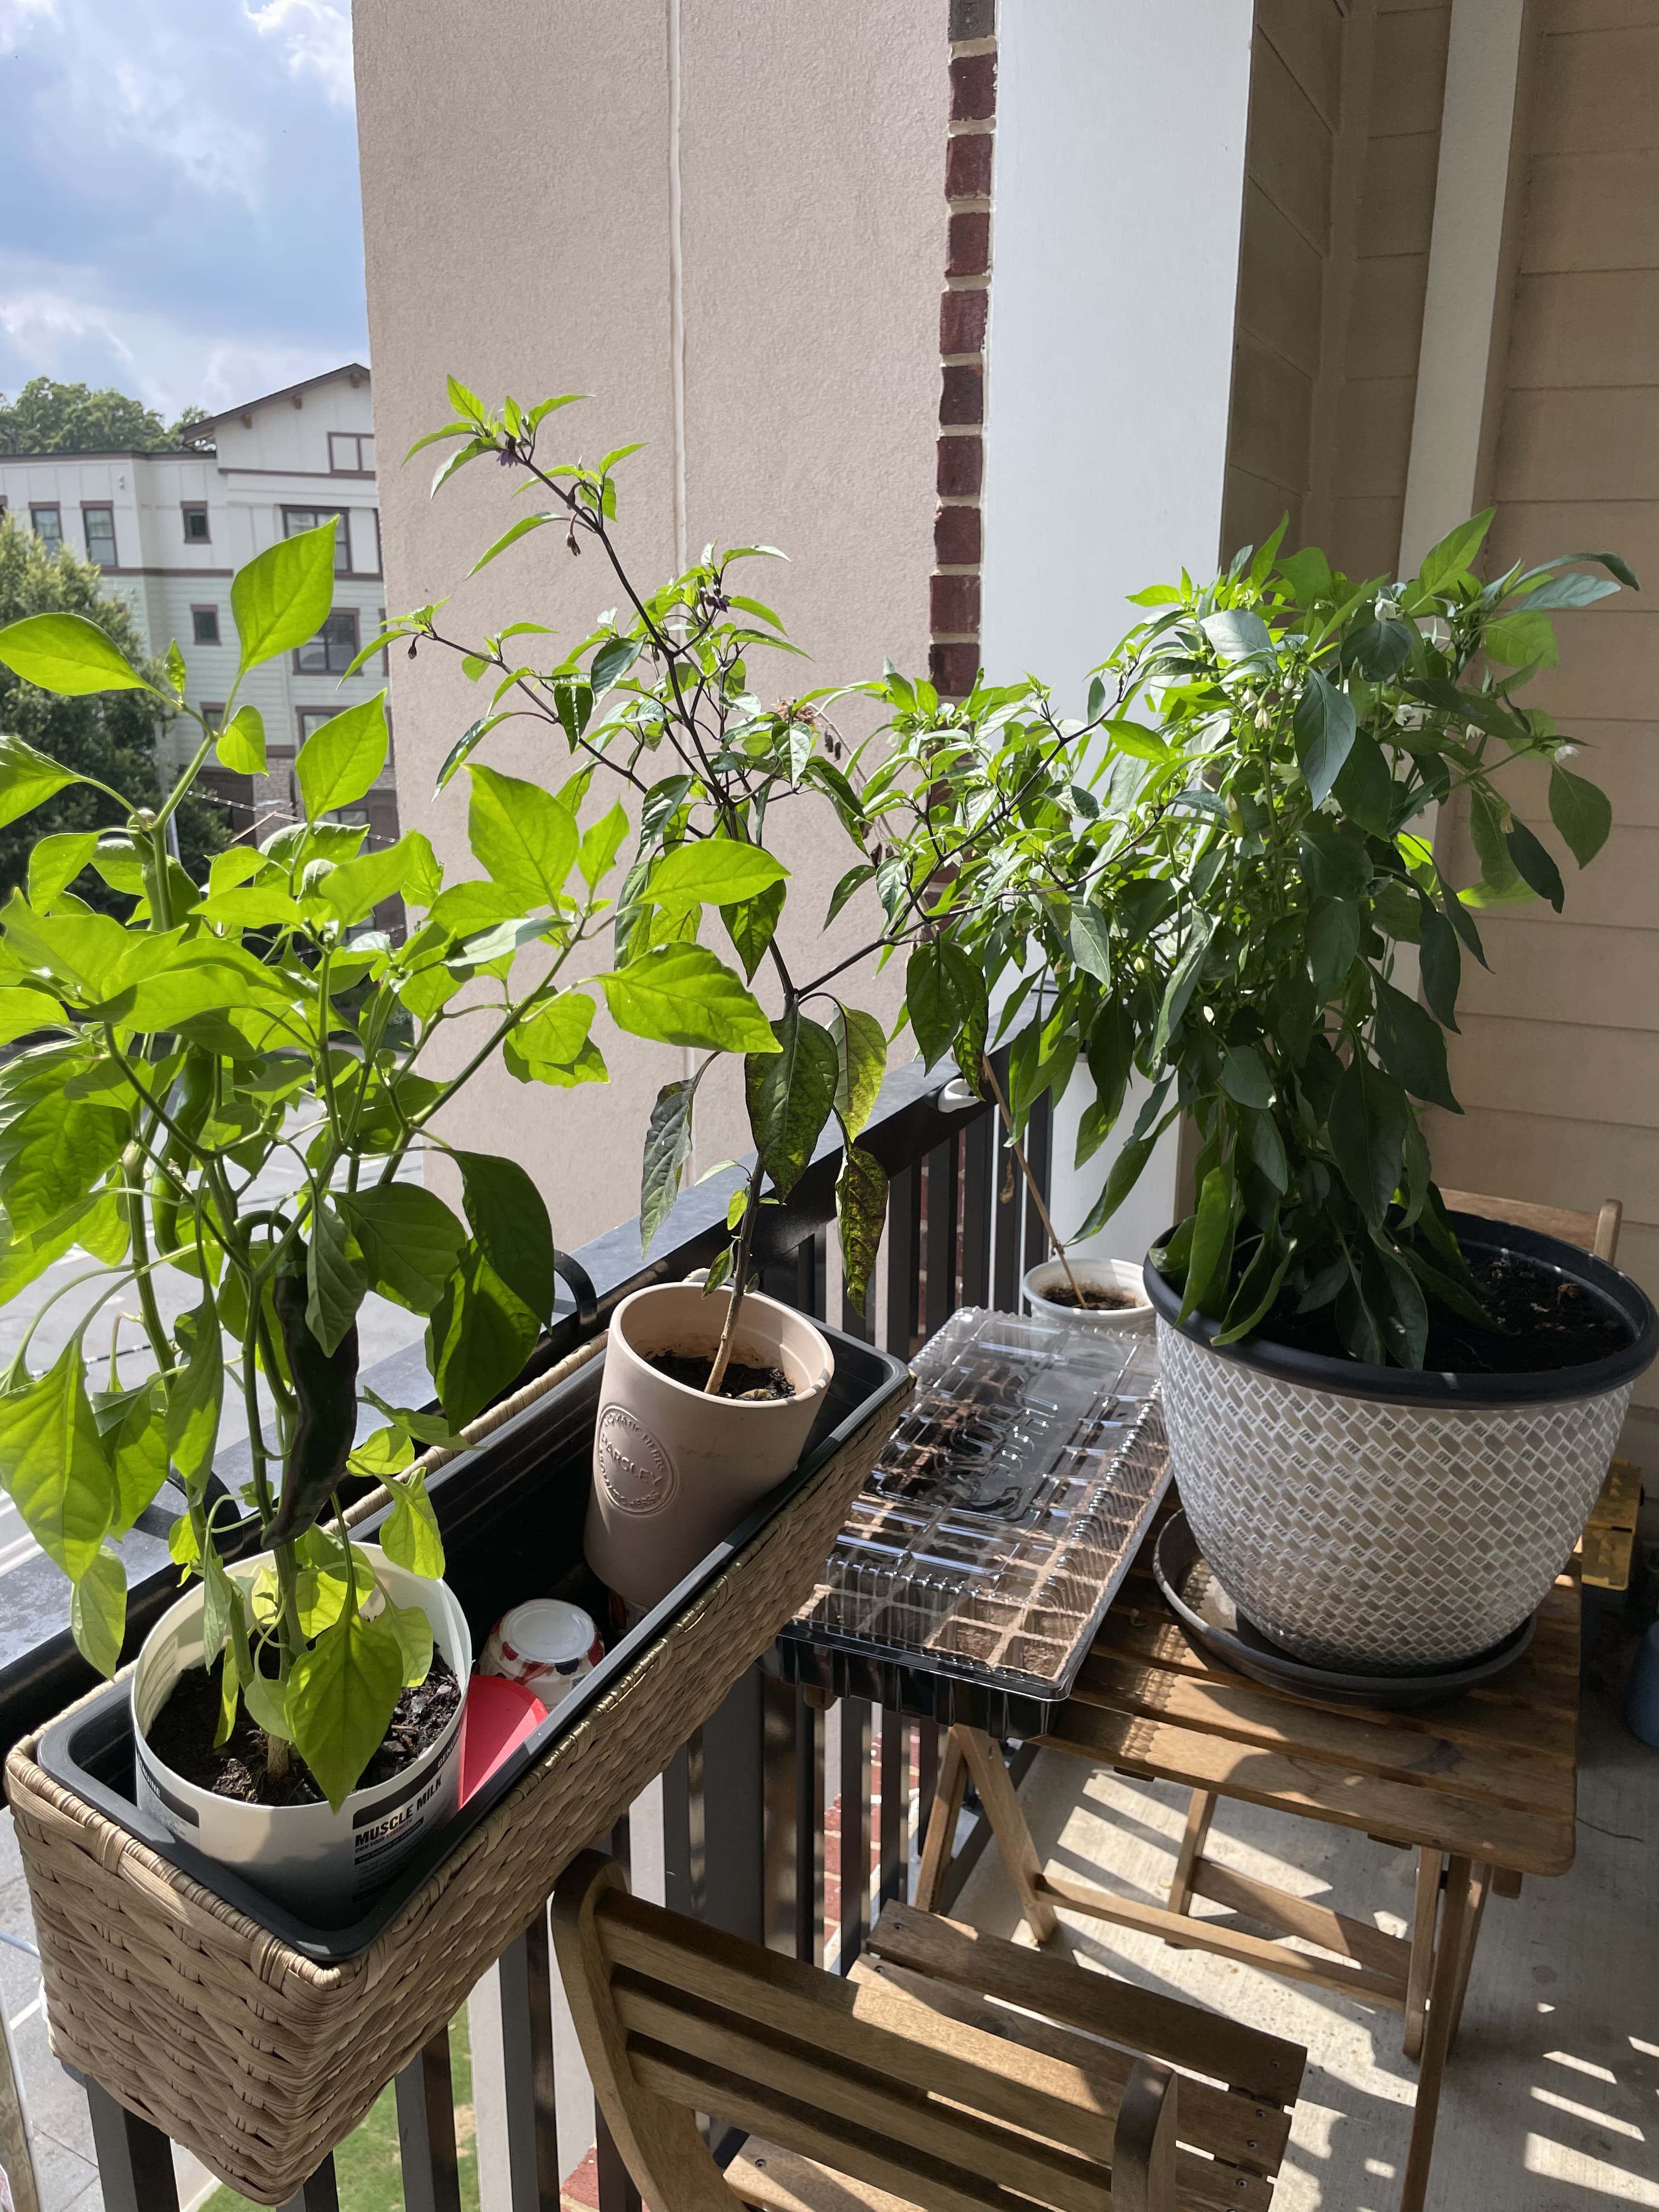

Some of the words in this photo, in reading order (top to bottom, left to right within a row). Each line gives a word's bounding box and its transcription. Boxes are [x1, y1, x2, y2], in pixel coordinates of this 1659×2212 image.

[138, 1753, 161, 1797] NUINE
[356, 1804, 413, 1847] MUSCLE
[417, 1773, 443, 1811] MILK
